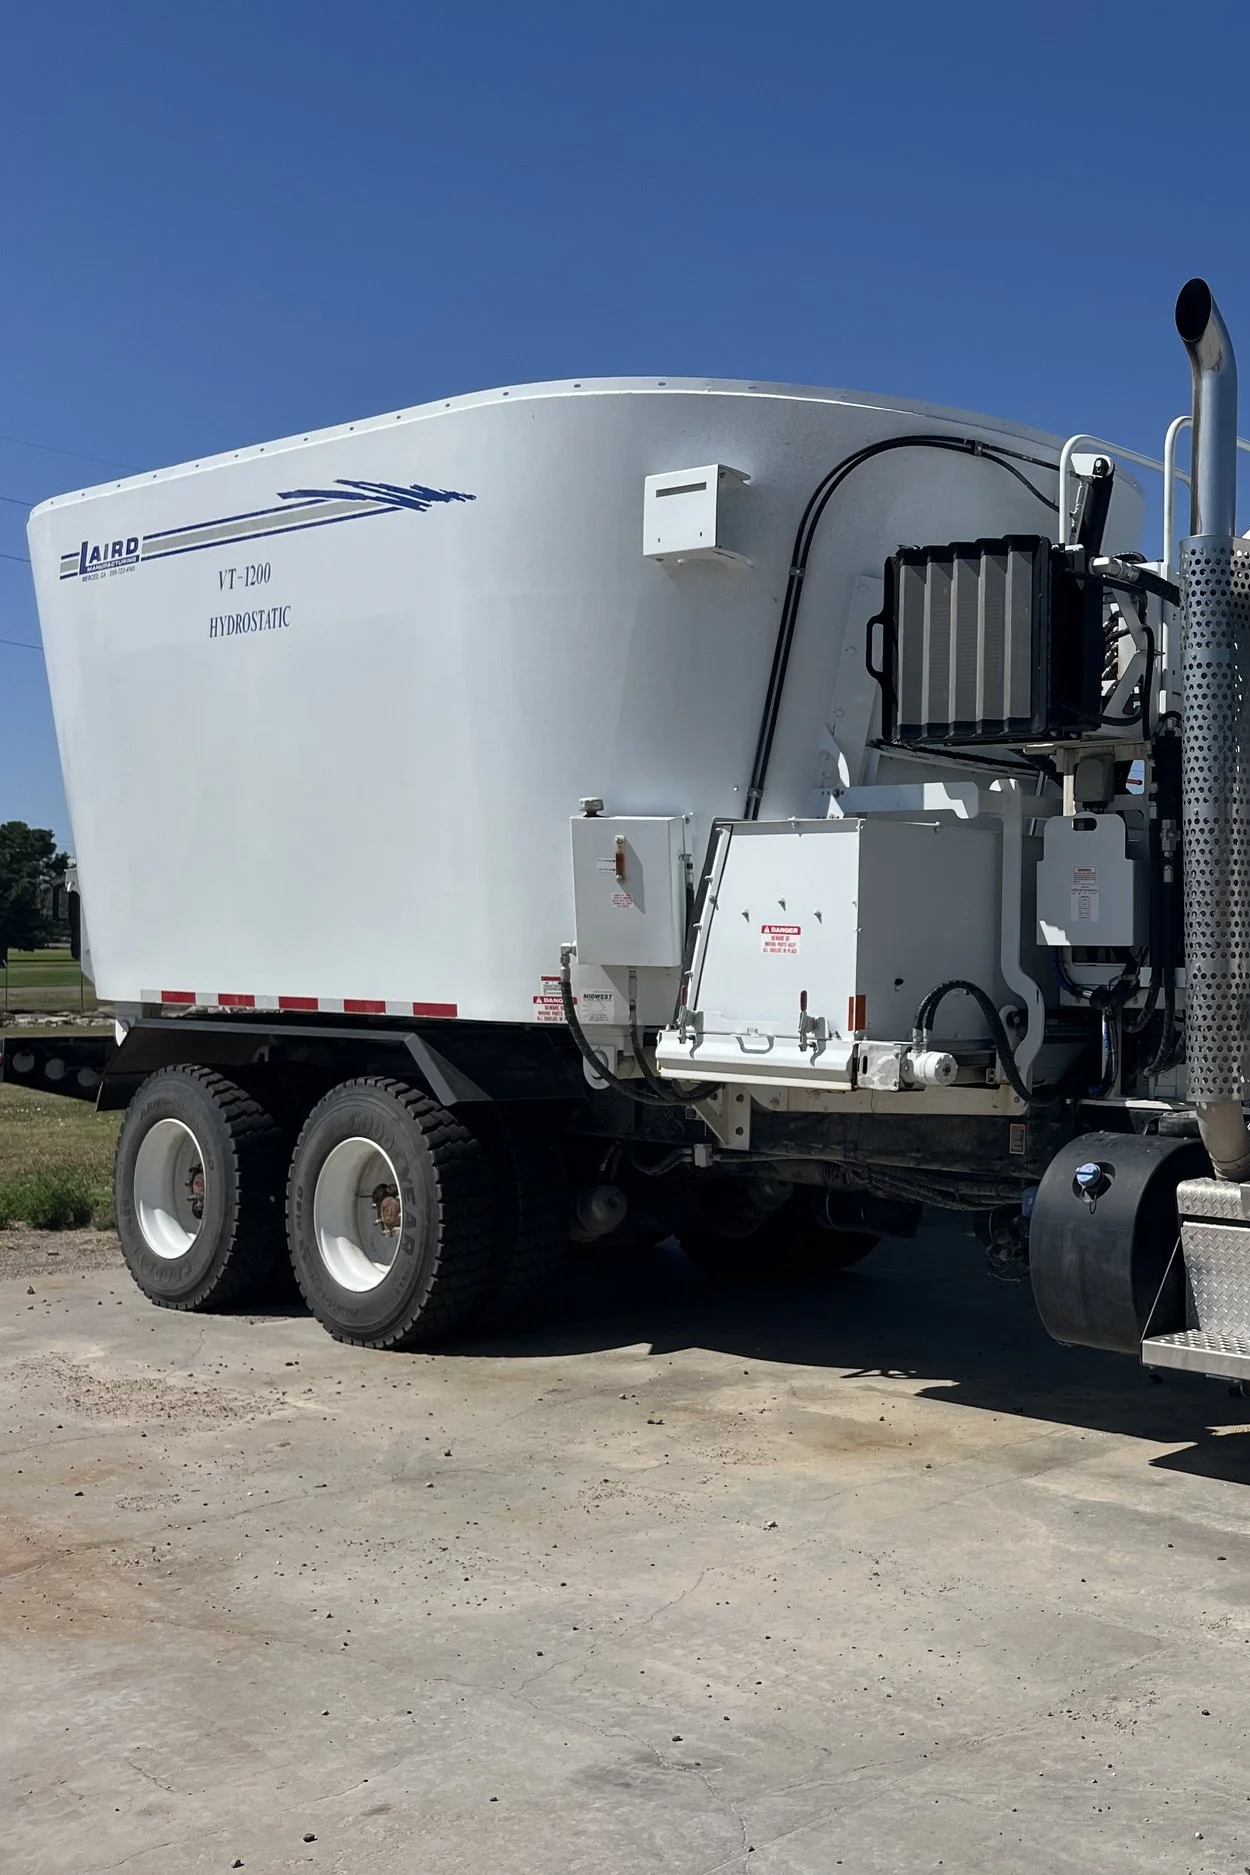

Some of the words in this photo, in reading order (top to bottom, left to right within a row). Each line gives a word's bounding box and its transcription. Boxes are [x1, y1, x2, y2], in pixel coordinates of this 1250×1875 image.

[79, 537, 139, 575] LAIRD
[219, 562, 271, 591] VT-1200
[209, 605, 291, 638] HYDROSTATIC
[771, 926, 799, 934] DANGER
